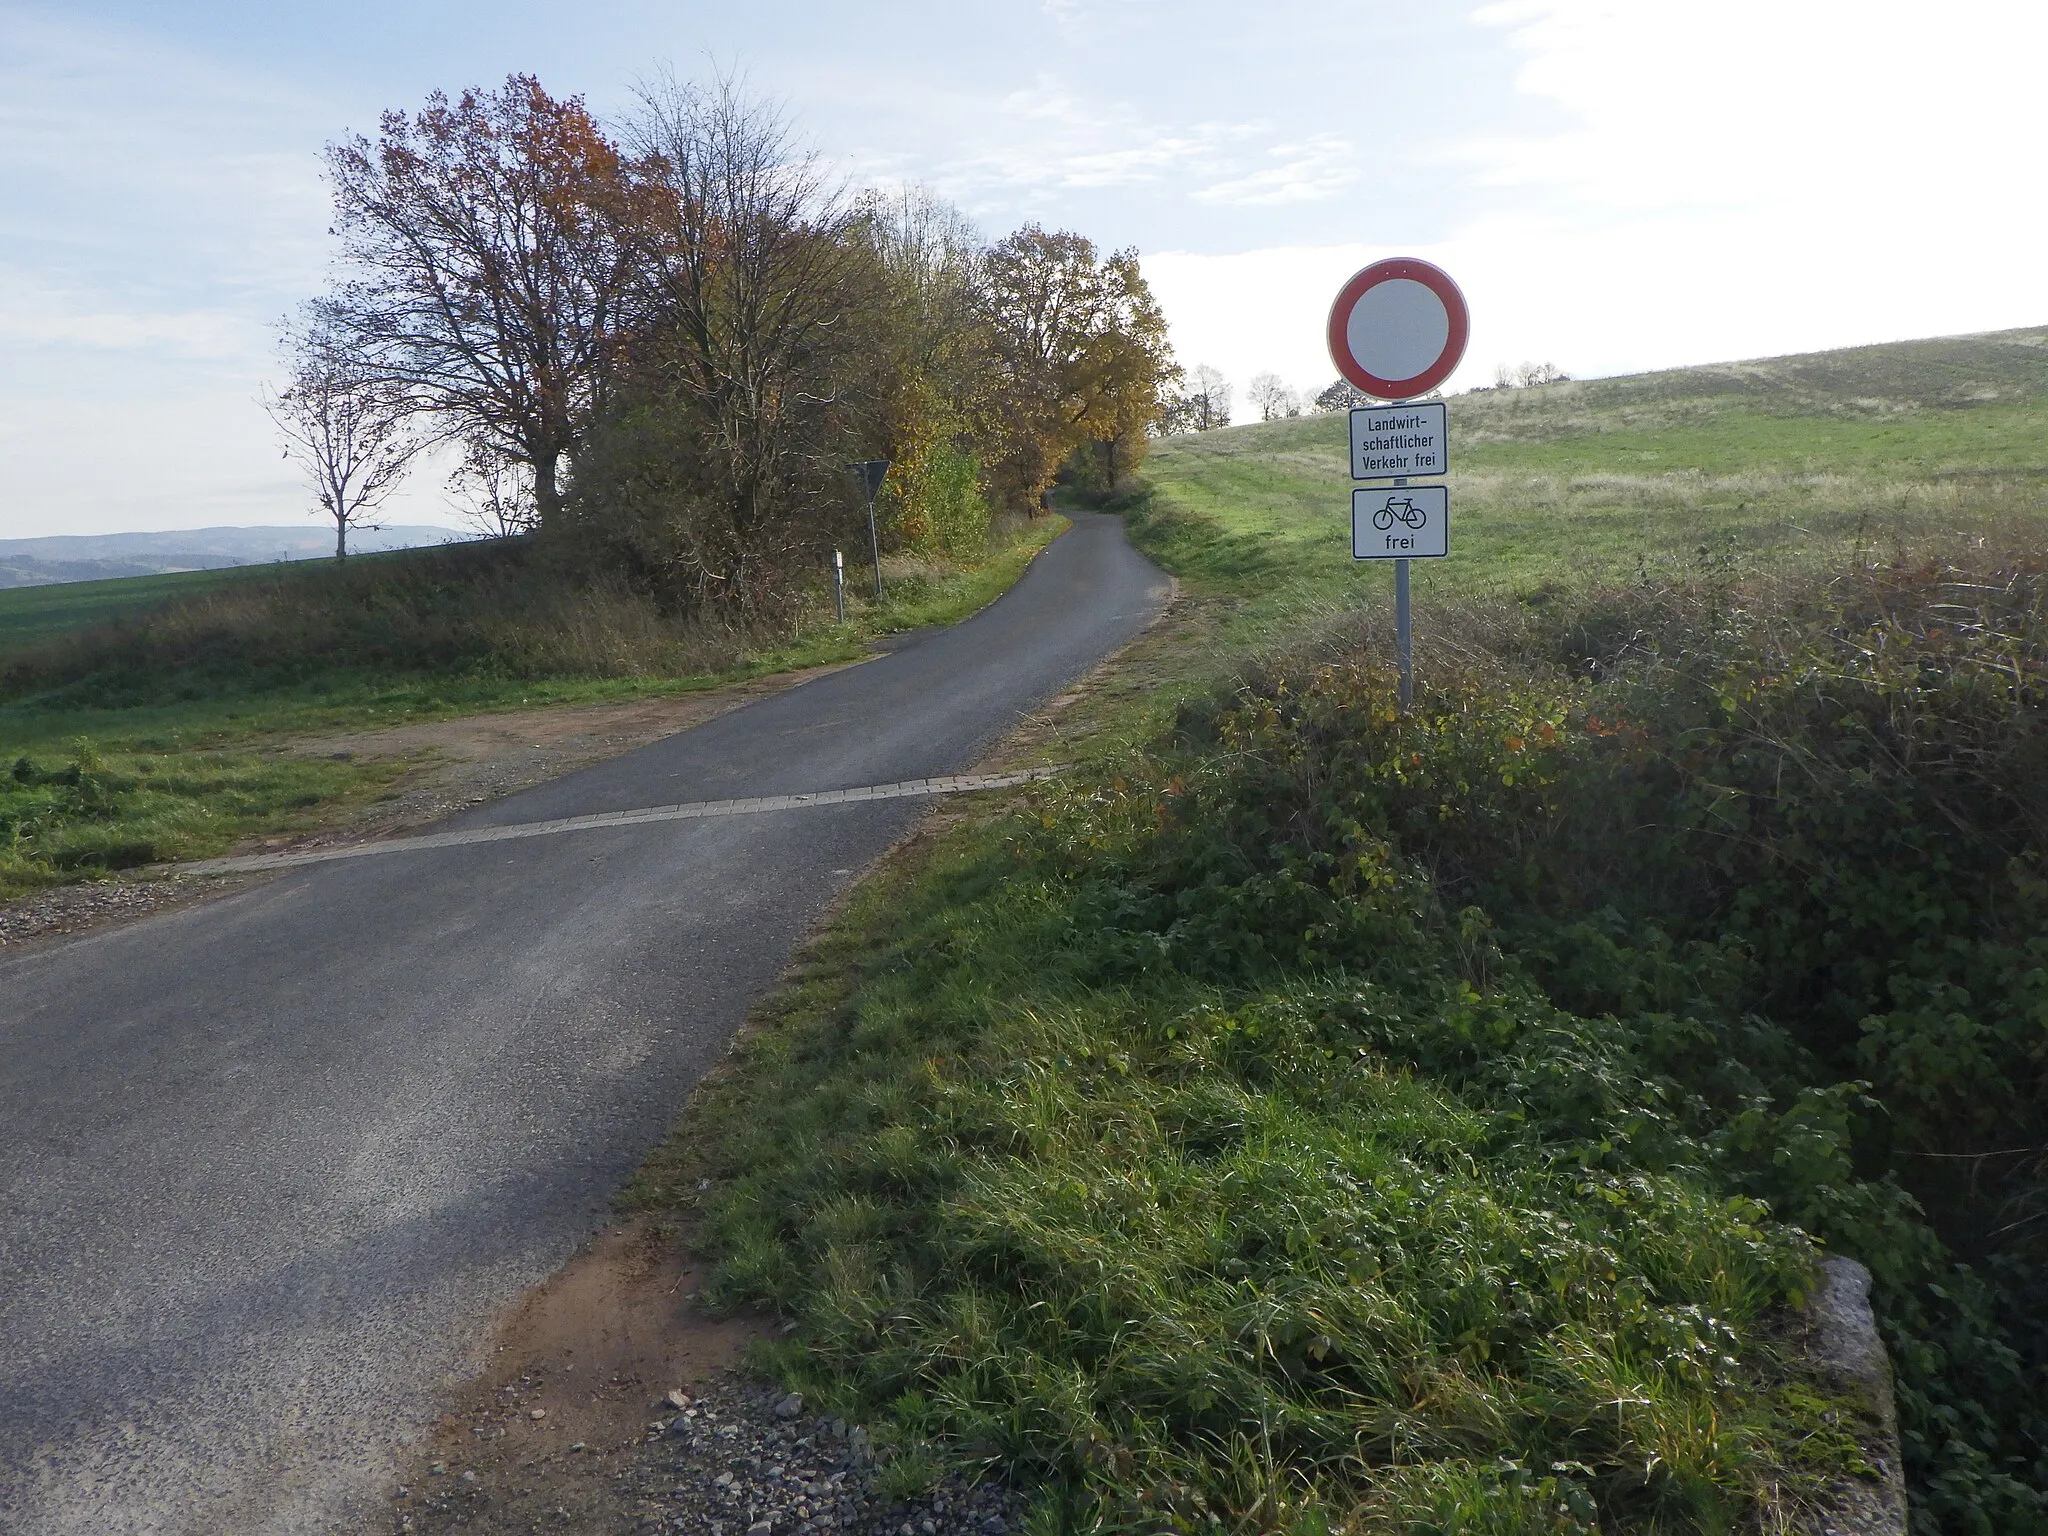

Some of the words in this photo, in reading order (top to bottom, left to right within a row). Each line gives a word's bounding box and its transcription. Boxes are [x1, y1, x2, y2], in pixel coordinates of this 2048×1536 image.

[1368, 415, 1427, 432] Landwirt-
[1363, 434, 1434, 451] schaftlicher
[1363, 455, 1408, 470] Verkehr
[1415, 452, 1435, 467] frei
[1385, 534, 1414, 549] frei
